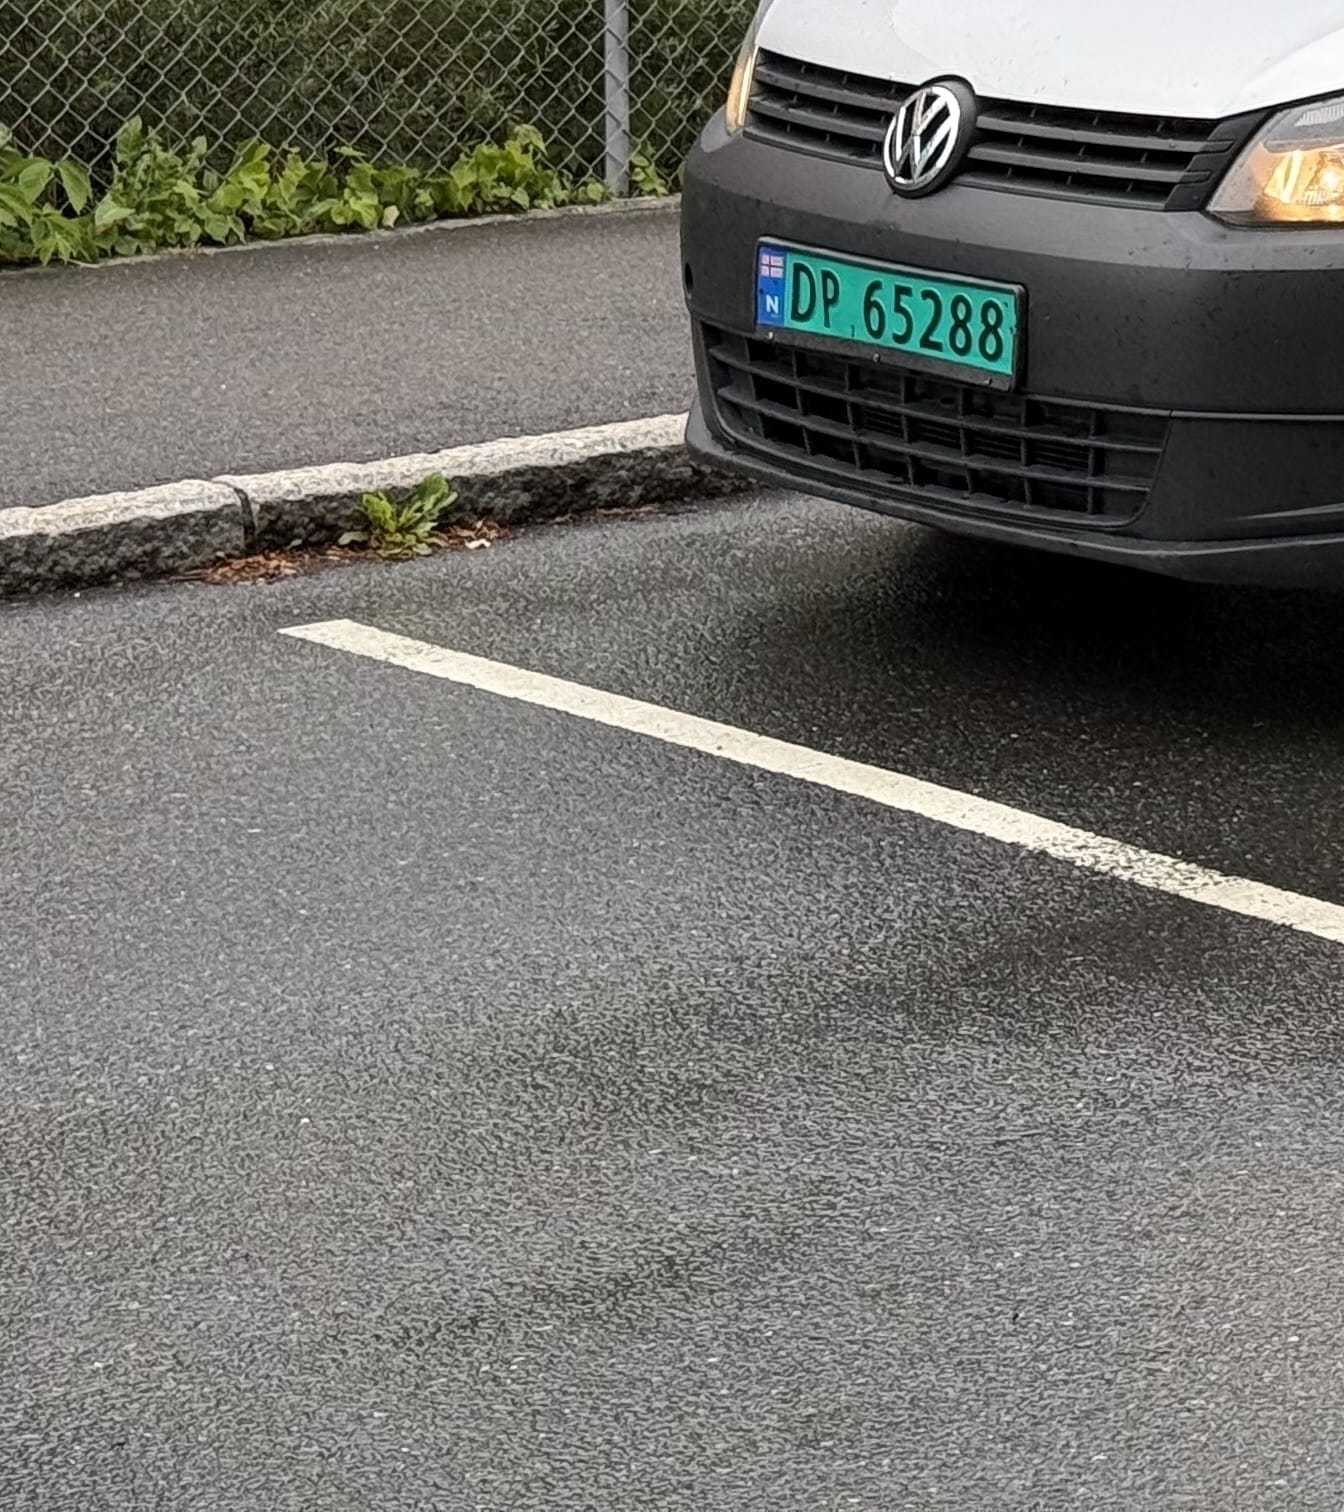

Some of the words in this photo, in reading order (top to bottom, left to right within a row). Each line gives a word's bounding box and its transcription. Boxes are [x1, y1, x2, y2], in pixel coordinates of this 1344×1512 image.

[766, 294, 779, 314] N
[790, 262, 840, 329] DP
[863, 280, 1004, 363] 65288
